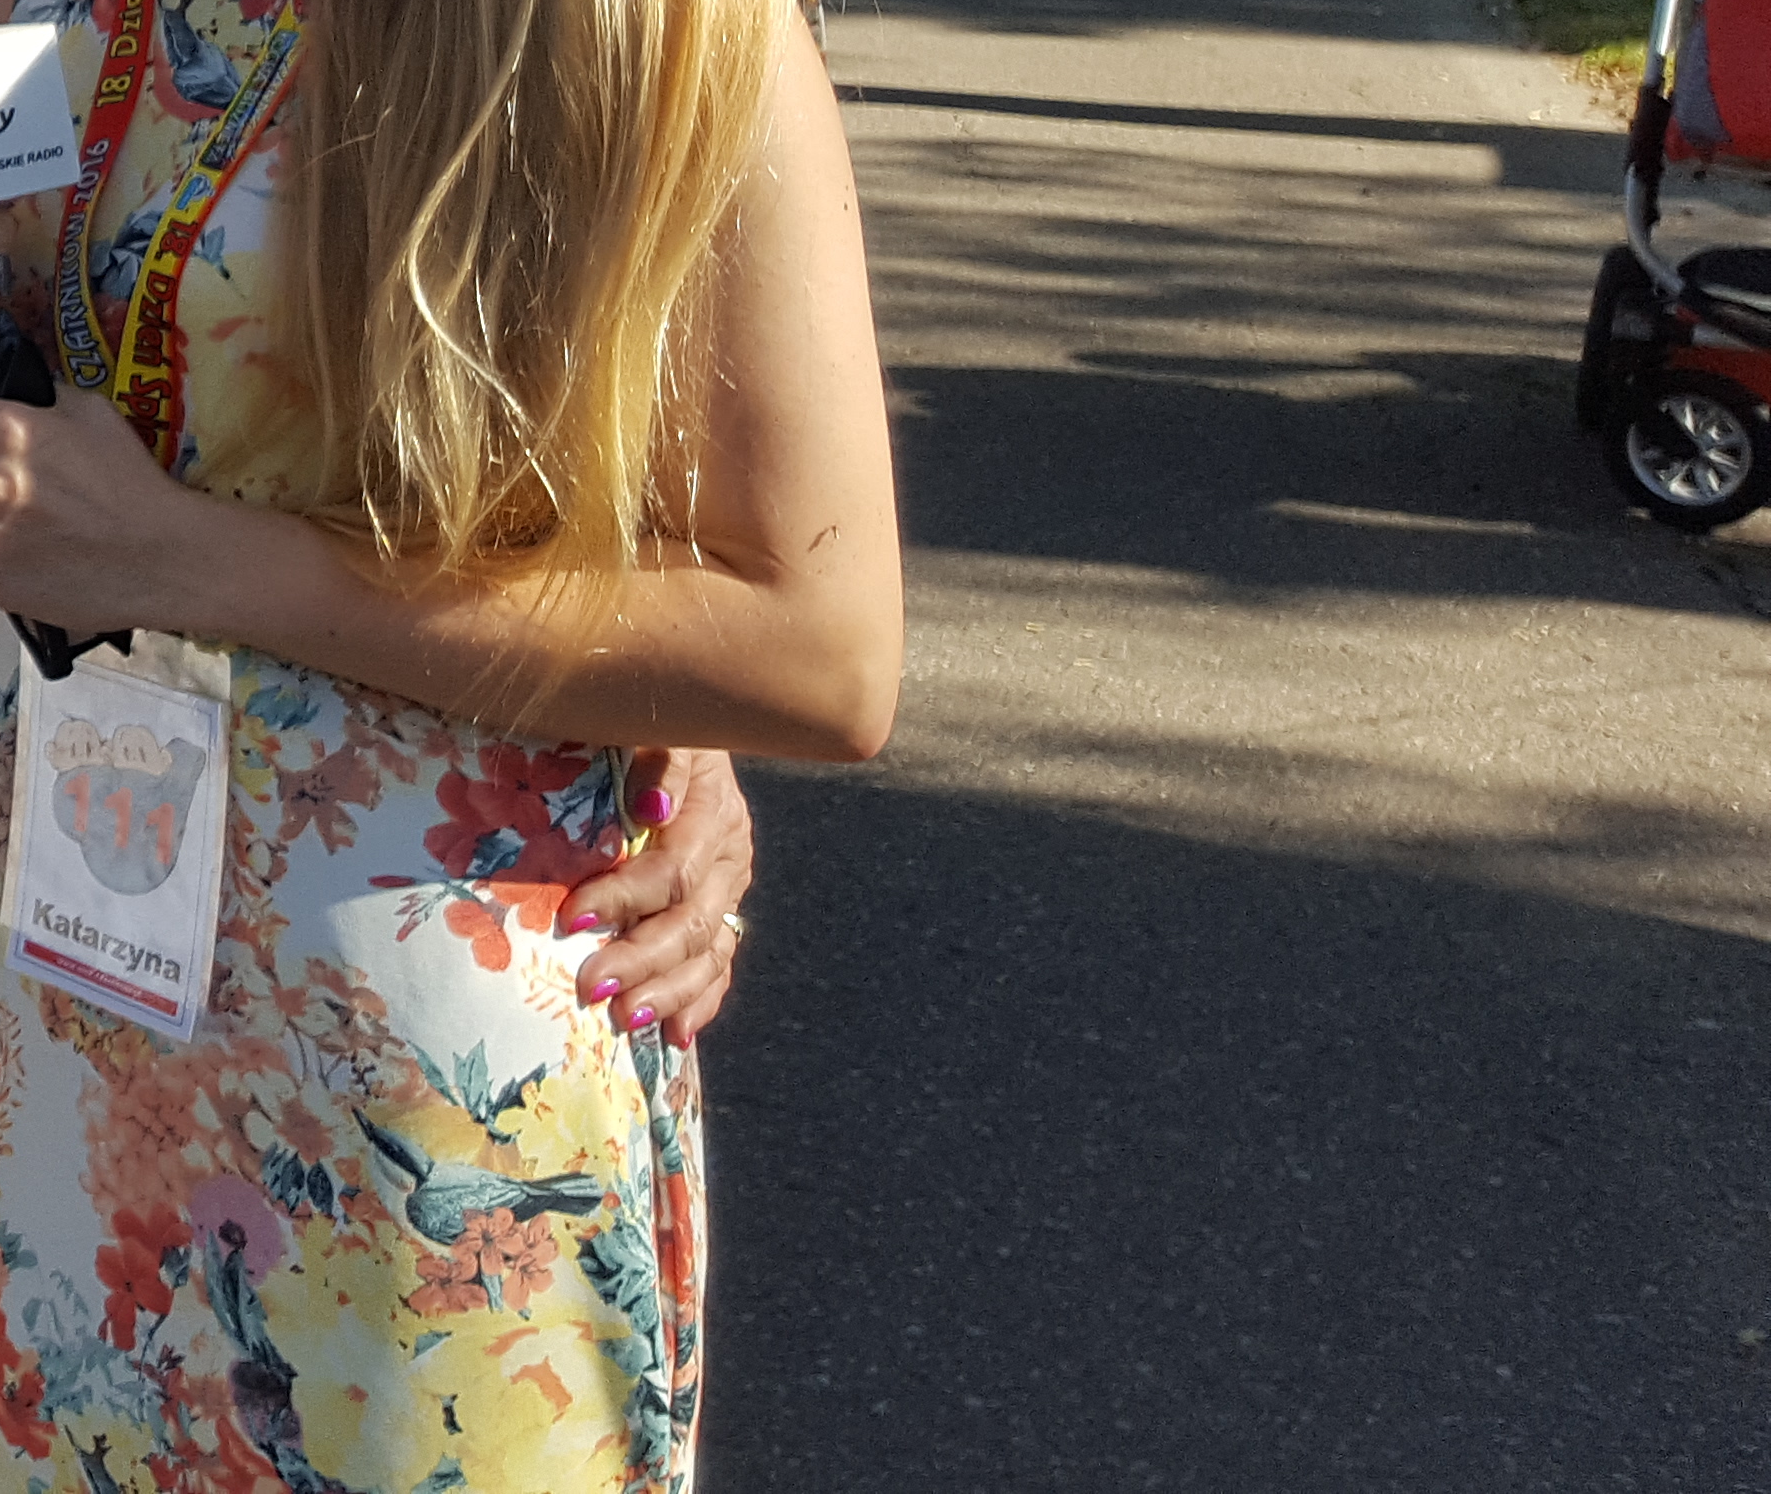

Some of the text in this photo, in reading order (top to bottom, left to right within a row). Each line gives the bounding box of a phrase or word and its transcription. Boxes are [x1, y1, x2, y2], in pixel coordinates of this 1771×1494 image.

[27, 145, 64, 165] RADIO
[72, 137, 111, 207] 2016
[31, 897, 182, 985] Katarzyna
